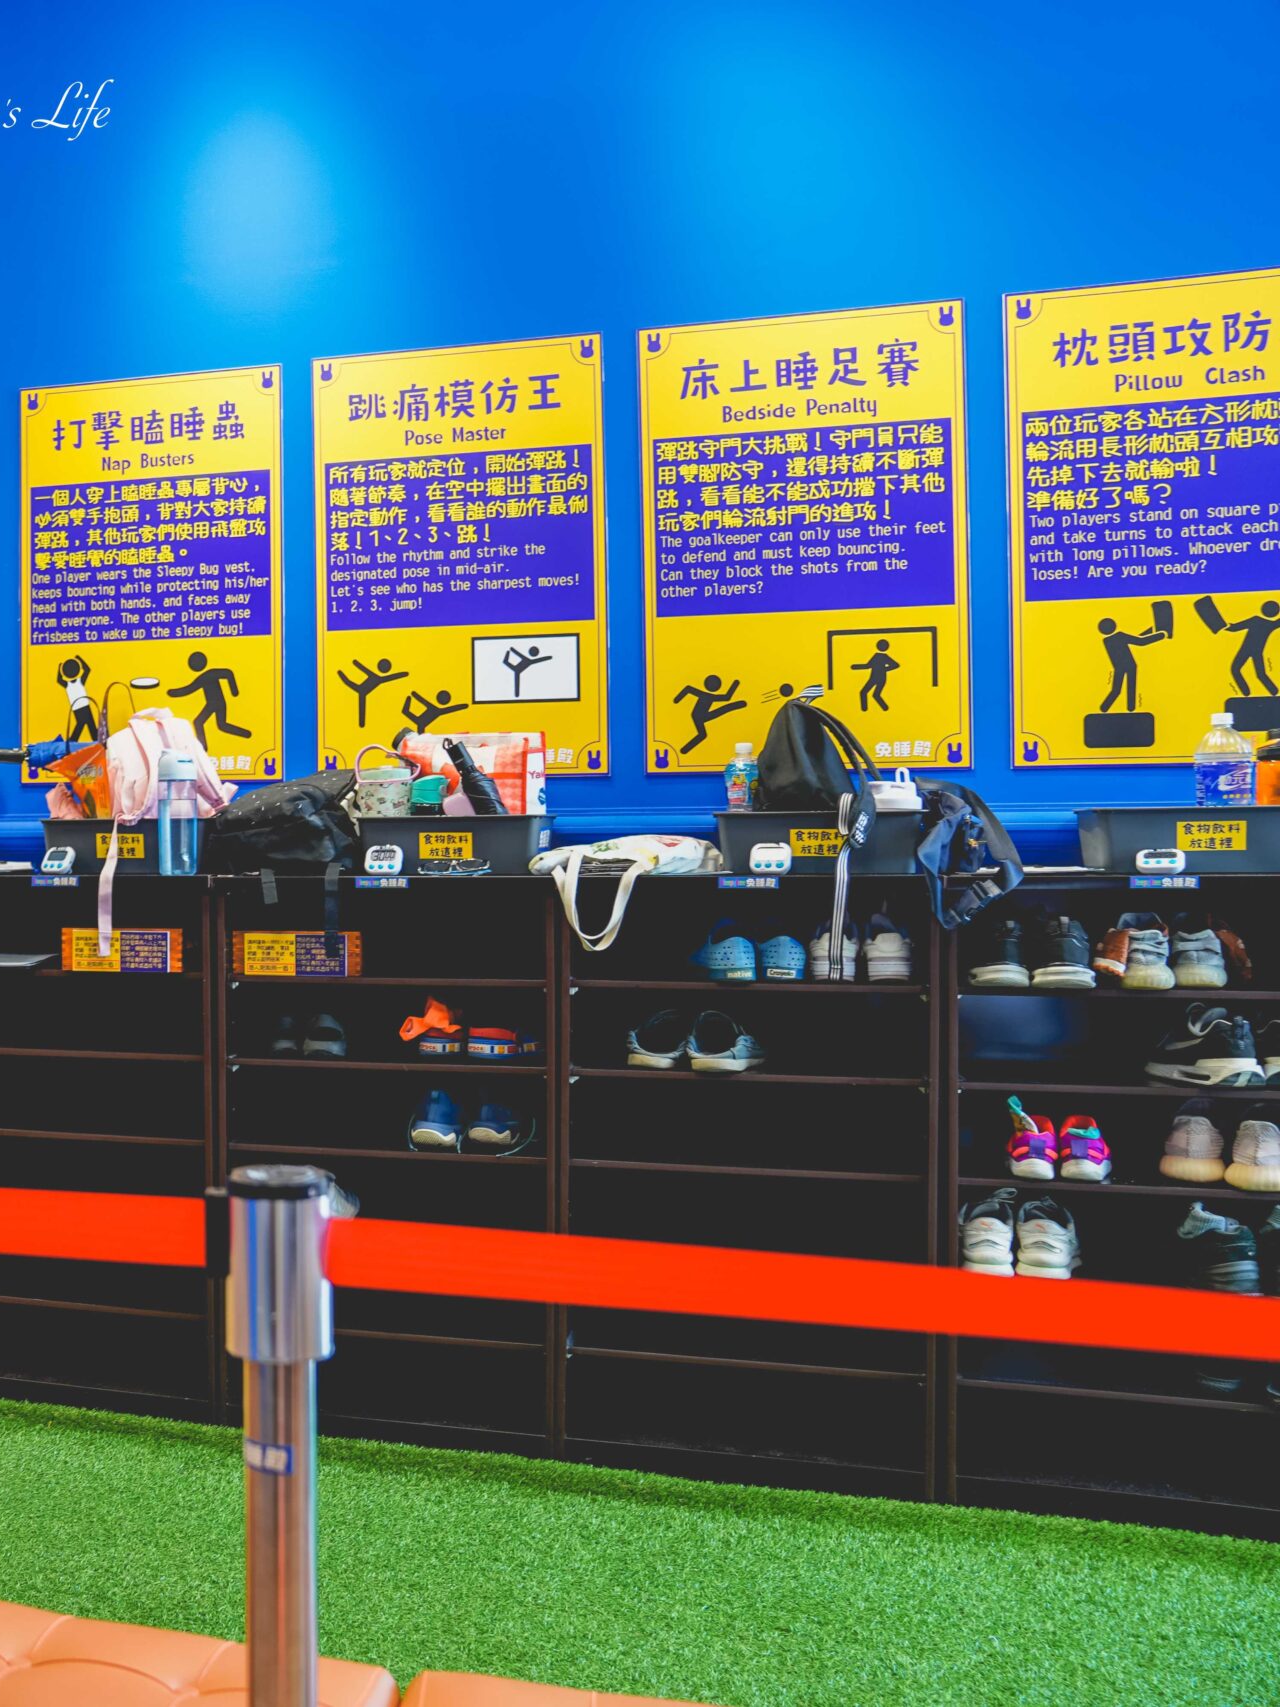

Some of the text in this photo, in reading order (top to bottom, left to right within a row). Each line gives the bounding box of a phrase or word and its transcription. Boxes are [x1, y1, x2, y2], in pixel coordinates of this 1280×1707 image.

[1052, 310, 1272, 368] 枕頭攻防
[680, 338, 919, 400] 床上睡足賽
[1115, 365, 1265, 392] Pillow Clash
[348, 374, 561, 422] 跳痛模仿王
[722, 397, 877, 423] Bedside Penalty
[1025, 397, 1280, 437] 兩位玩家各站在方形枕
[52, 401, 245, 450] 打擊瞌睡蟲
[405, 426, 507, 445] Pose Master
[1025, 423, 1280, 462] 輪流用長形枕頭互相攻
[102, 453, 195, 474] Nap Busters
[1026, 454, 1217, 487] 先掉下去就輸啦！
[1026, 483, 1171, 511] 準備好了嗎？
[1029, 514, 1054, 527] Two
[1062, 512, 1120, 527] players
[1129, 507, 1172, 522] stand
[1179, 508, 1198, 519] on
[1207, 504, 1260, 518] square
[660, 520, 946, 547] The goalkeeper can only use their feet
[1029, 519, 1278, 545] and take turns to attack each
[330, 543, 545, 565] Follow the rhythm and strike the
[661, 541, 904, 564] to defend and must keep bouncing.
[1029, 549, 1063, 563] with
[1072, 548, 1104, 561] long
[1188, 541, 1251, 554] Whoever
[32, 562, 219, 584] One player wears the Sleepy Bug
[330, 561, 509, 581] designated pose in mid-air.
[660, 557, 908, 581] Can they block the shots from the
[1031, 559, 1206, 580] loses! Are you ready?
[31, 575, 269, 598] keeps bouncing while protecting his/her
[370, 585, 390, 595] see
[395, 582, 417, 593] who
[422, 581, 443, 592] has
[449, 579, 470, 591] the
[477, 576, 531, 590] sharpest
[538, 573, 578, 586] moves!
[661, 580, 763, 597] other players?
[389, 597, 421, 611] jump!
[32, 622, 242, 642] frisbees to wake up the sleepy bug!
[100, 835, 139, 845] 食飲料
[424, 834, 468, 845] 食物飲料
[1183, 823, 1240, 835] 食物飲料
[1189, 837, 1233, 849] 放這裡
